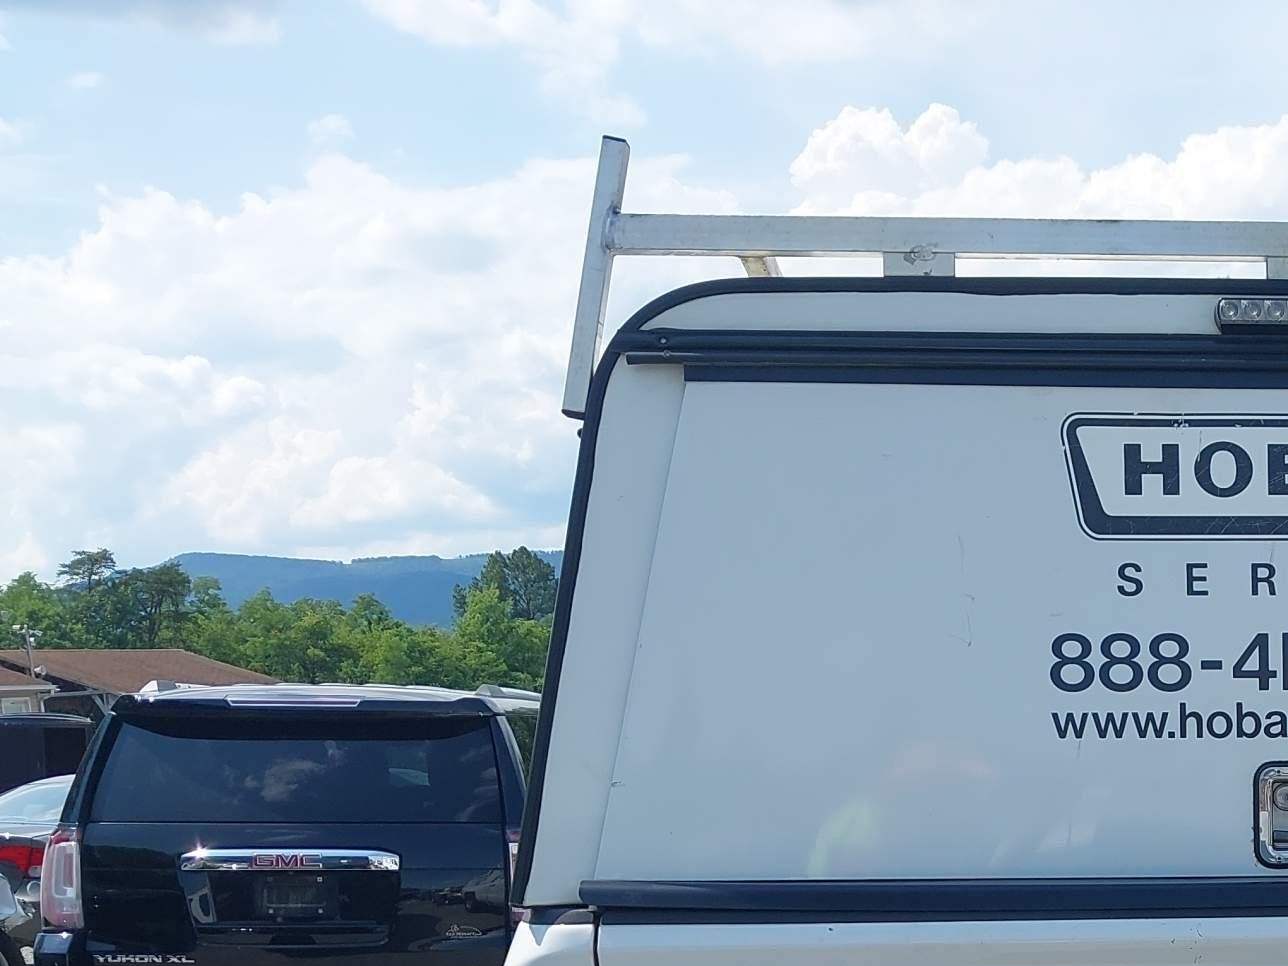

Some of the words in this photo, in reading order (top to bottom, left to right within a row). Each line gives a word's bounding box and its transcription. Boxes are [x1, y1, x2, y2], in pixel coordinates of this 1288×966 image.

[250, 853, 324, 870] GMC
[94, 953, 167, 965] YUKON
[167, 953, 196, 965] XL
